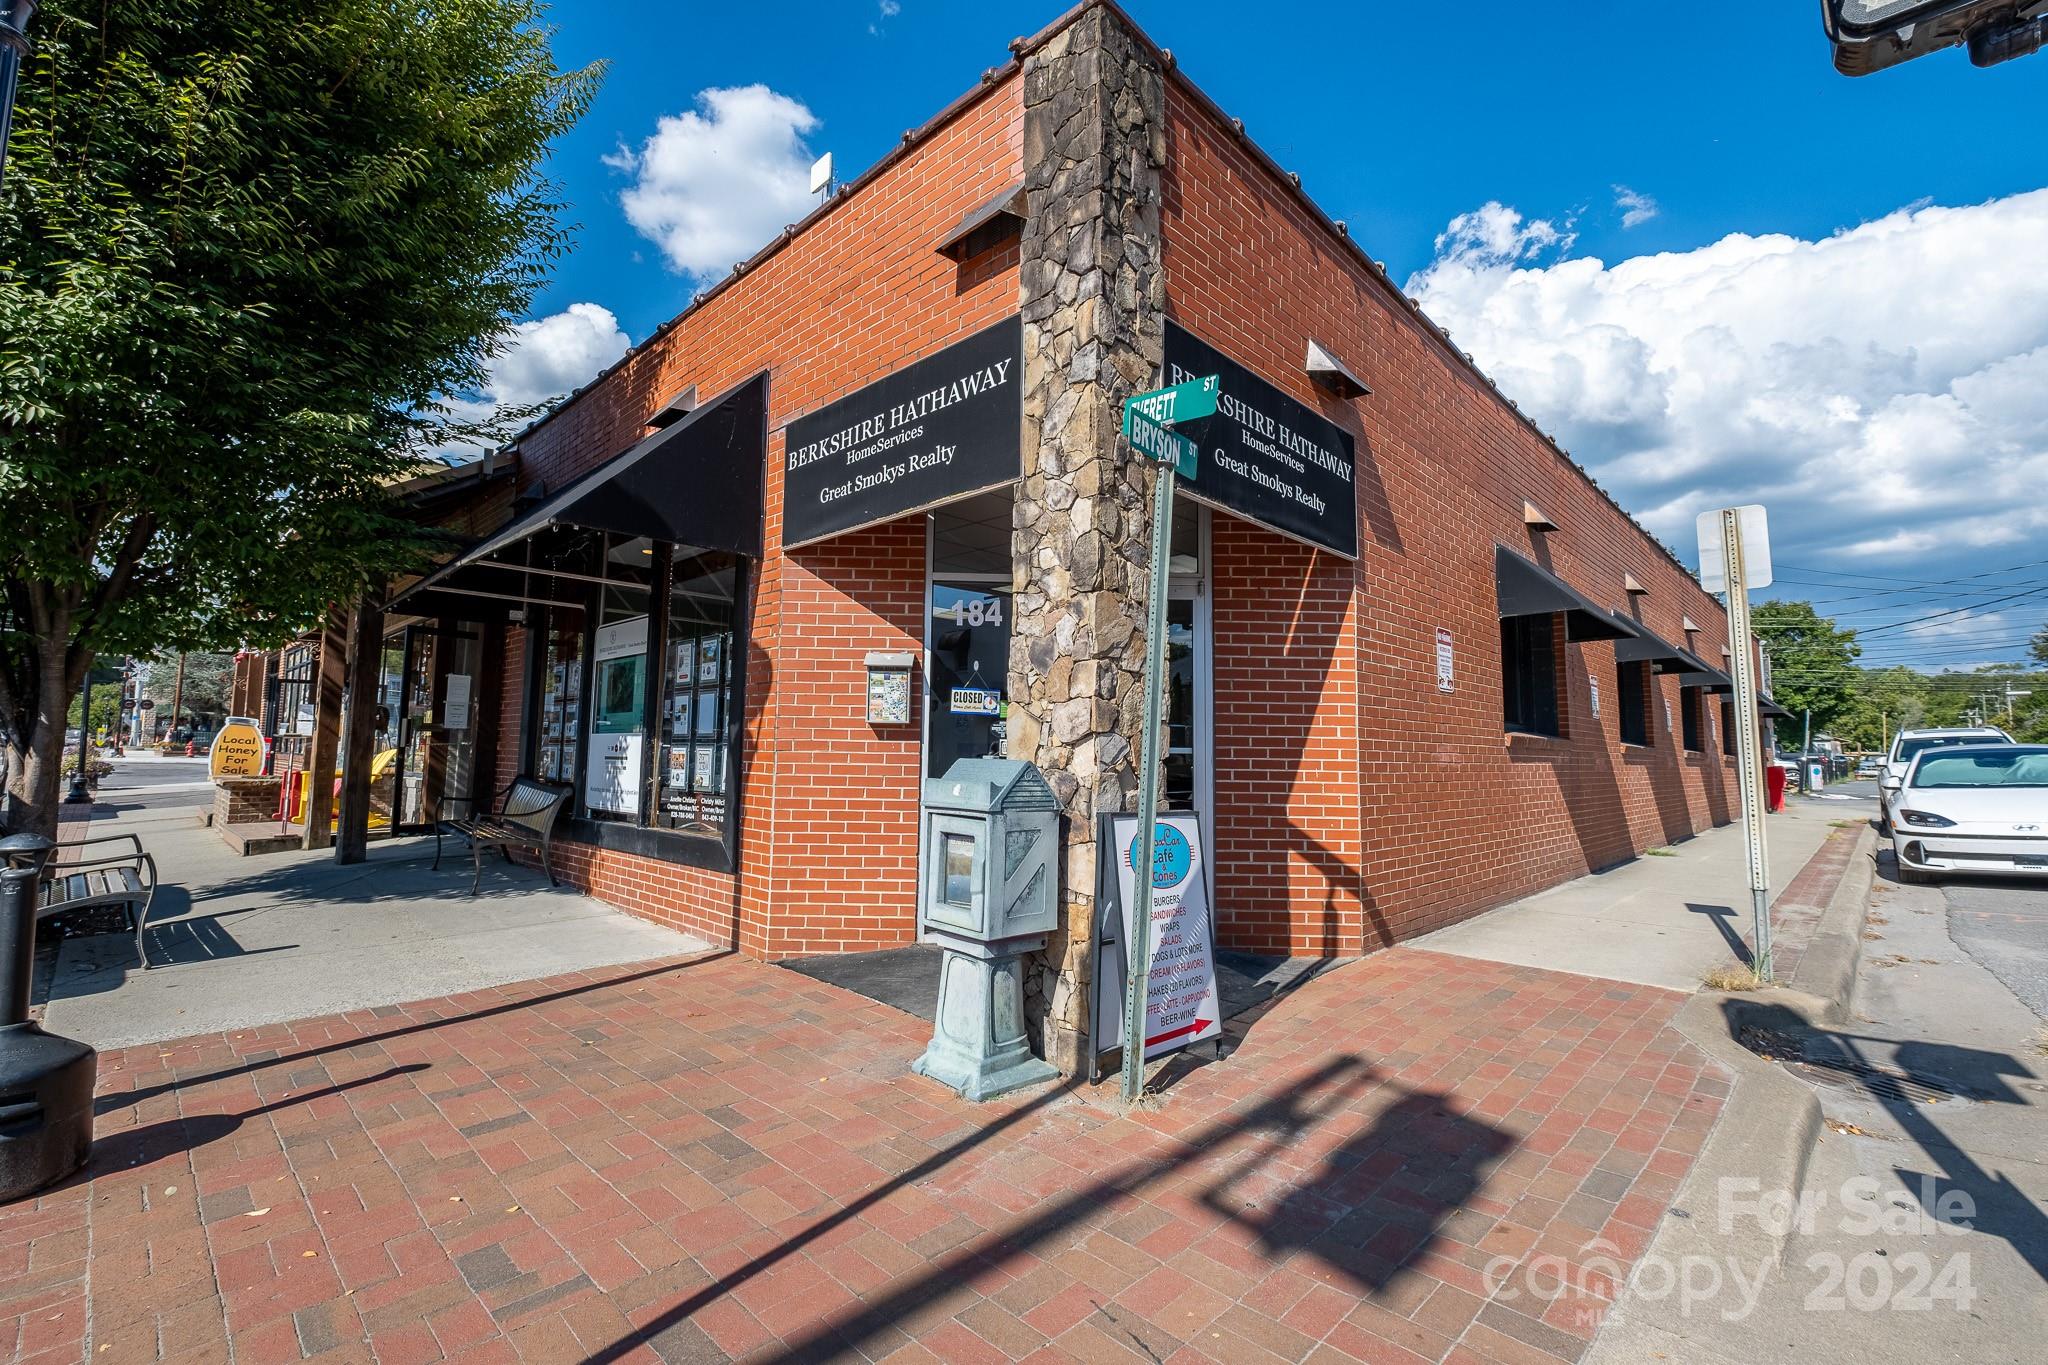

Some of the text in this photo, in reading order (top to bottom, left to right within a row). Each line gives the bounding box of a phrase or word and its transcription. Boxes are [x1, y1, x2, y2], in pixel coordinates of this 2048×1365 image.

[1203, 376, 1216, 392] ST
[788, 358, 1012, 471] BERKSHIRE HATHAWAY
[846, 425, 923, 466] HomeServices
[1132, 415, 1198, 467] BRYSON ST
[1242, 429, 1305, 474] HomeServices
[1279, 424, 1352, 483] HATHAWAY
[820, 444, 956, 504] Great Smokys Realty
[1214, 448, 1326, 516] Great Smokys Realty
[951, 598, 1003, 627] 184
[953, 691, 983, 704] CLOSED
[223, 736, 256, 745] Local
[218, 745, 258, 757] Honey
[225, 756, 248, 764] For
[220, 766, 249, 775] Sale
[1154, 828, 1181, 847] oxCar
[1152, 871, 1178, 882] Cones
[1153, 894, 1181, 907] BURGERS
[1151, 906, 1187, 921] SANDWICHES
[1159, 920, 1180, 933] WRAPS
[1160, 934, 1183, 947] SALADS
[1151, 943, 1203, 963] DOGS & LOTS MORE
[1150, 966, 1171, 980] CREAM
[1181, 958, 1206, 973] FLAVORS)
[1147, 983, 1169, 998] HAKES
[1179, 975, 1204, 990] FLAVORS)
[1163, 997, 1179, 1011] LATTE
[1181, 988, 1211, 1006] CAPPUCCINO
[1160, 1008, 1197, 1027] BEER-WINE
